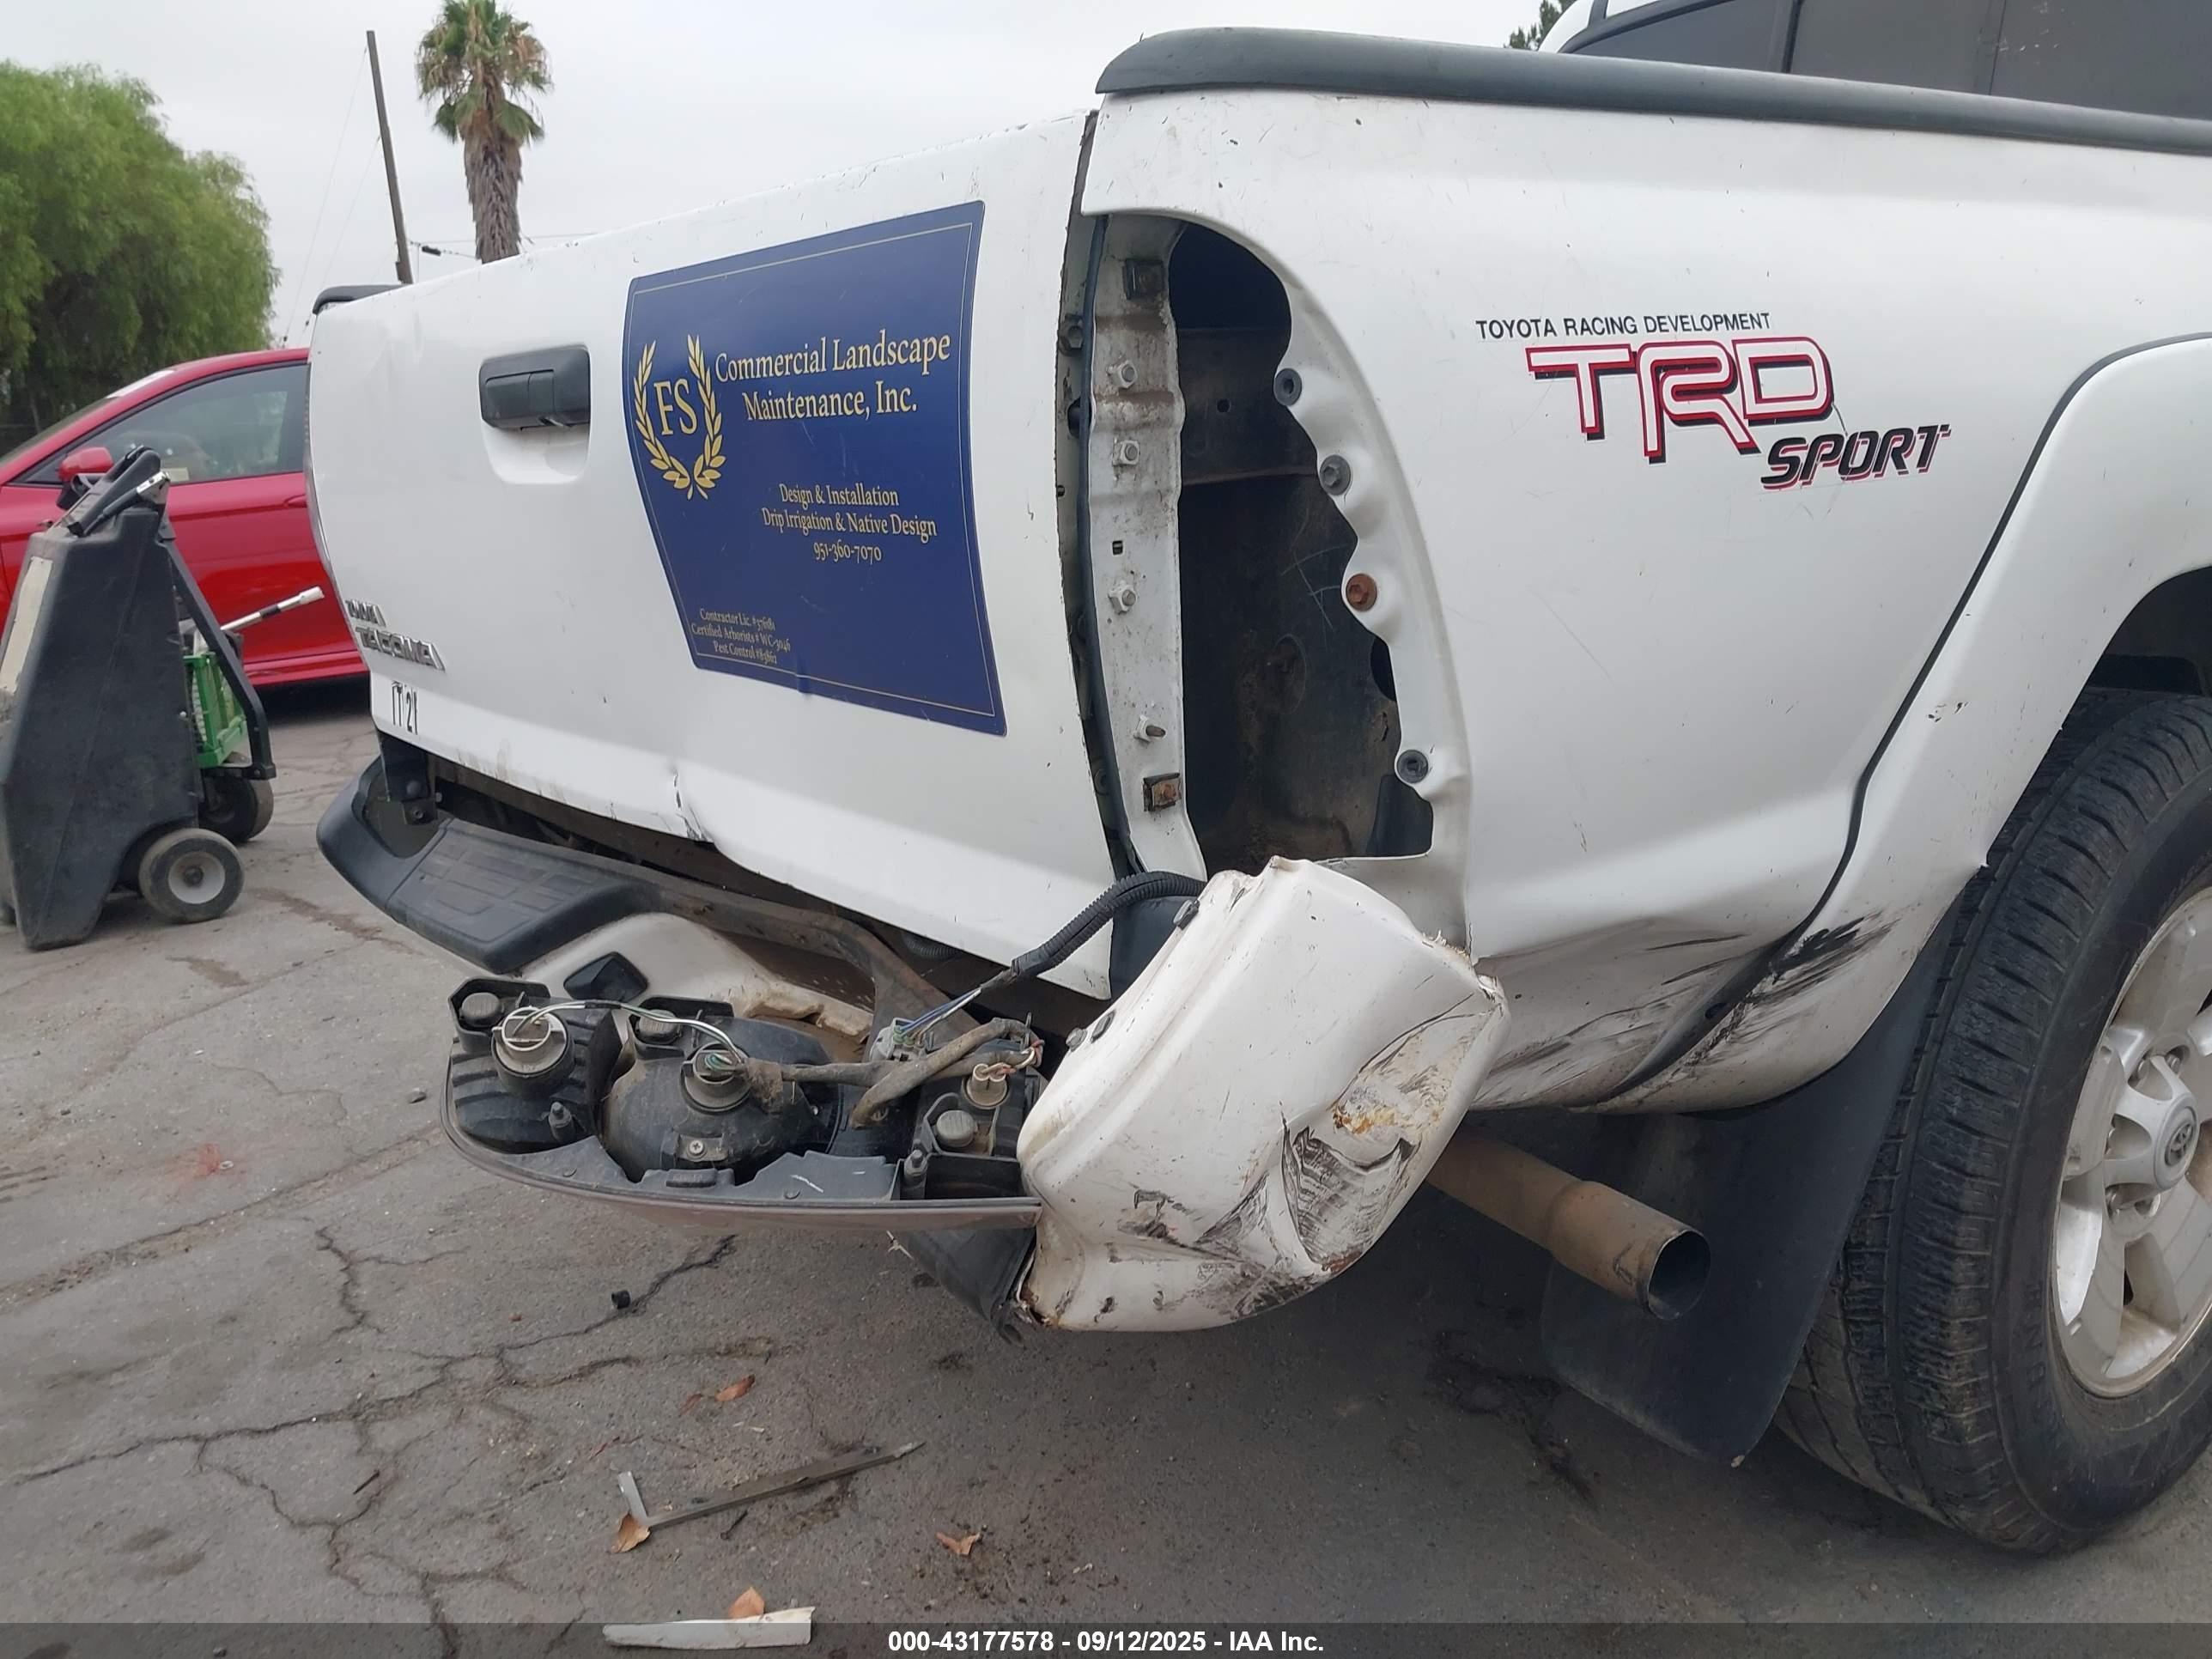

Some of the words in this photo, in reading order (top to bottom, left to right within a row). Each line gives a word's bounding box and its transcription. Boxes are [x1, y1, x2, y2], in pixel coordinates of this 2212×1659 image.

[1476, 318, 1558, 340] TOYOTA
[1564, 316, 1638, 337] RACING
[1644, 313, 1771, 334] DEVELOPMENT
[715, 336, 827, 382] Commercial
[832, 328, 951, 376] Landscape
[653, 378, 698, 436] FS
[742, 390, 871, 421] Maintenance,
[875, 380, 918, 414] Inc.
[1525, 336, 1835, 465] TRD
[1761, 424, 1952, 490] SPORT
[779, 483, 814, 510] Design
[815, 484, 825, 505] &
[826, 483, 900, 507] Installation
[762, 507, 784, 533] Drip
[786, 509, 834, 536] Irrigation
[836, 512, 846, 532] &
[846, 513, 888, 534] Native
[890, 514, 938, 544] Design
[813, 539, 882, 564] 951-360-7070
[691, 623, 722, 638] Certified
[700, 608, 738, 626] Contractor
[355, 626, 446, 672] TACOMA
[713, 641, 728, 653] Pest
[729, 643, 756, 659] Control
